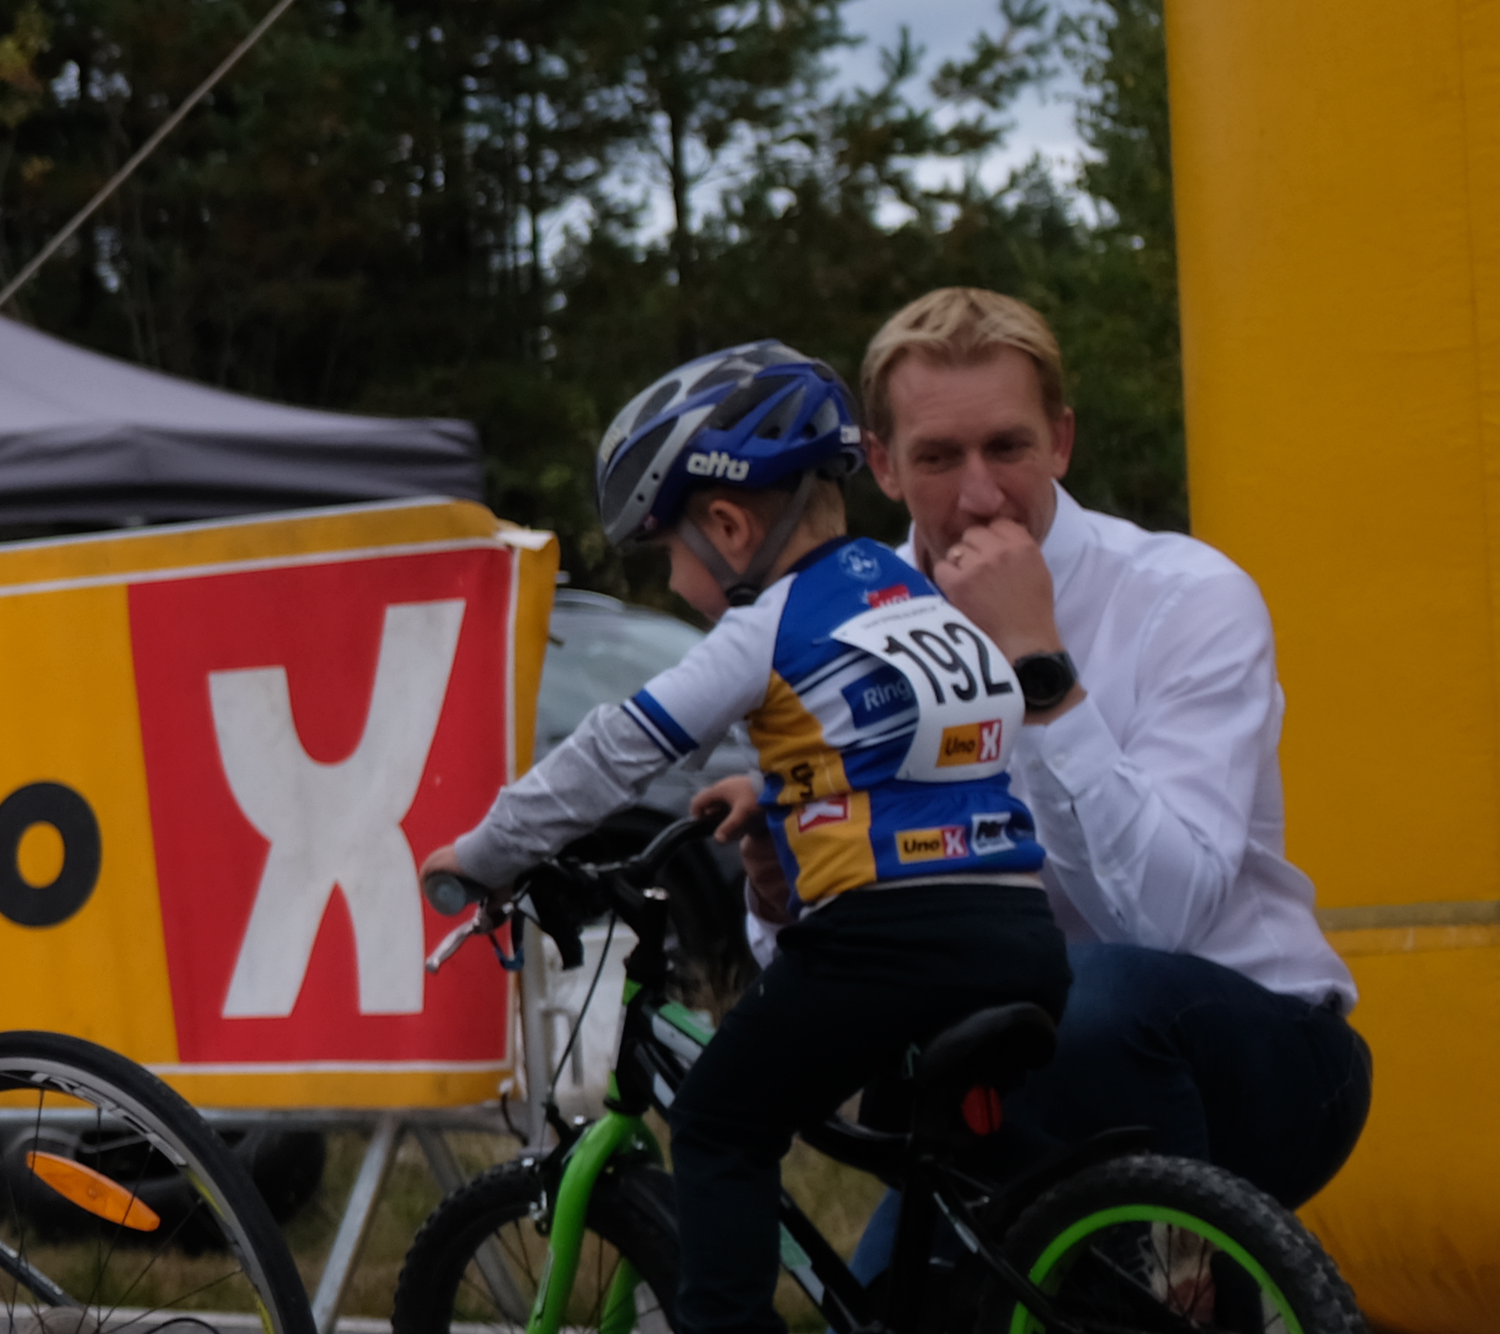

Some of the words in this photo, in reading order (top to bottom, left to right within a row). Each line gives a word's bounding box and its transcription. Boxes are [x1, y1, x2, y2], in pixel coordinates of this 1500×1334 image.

[686, 451, 750, 482] etto
[884, 623, 1014, 705] 192
[943, 735, 976, 756] Uno
[979, 721, 1001, 762] X
[206, 598, 466, 1019] X
[904, 838, 939, 854] Uno
[946, 826, 966, 855] X
